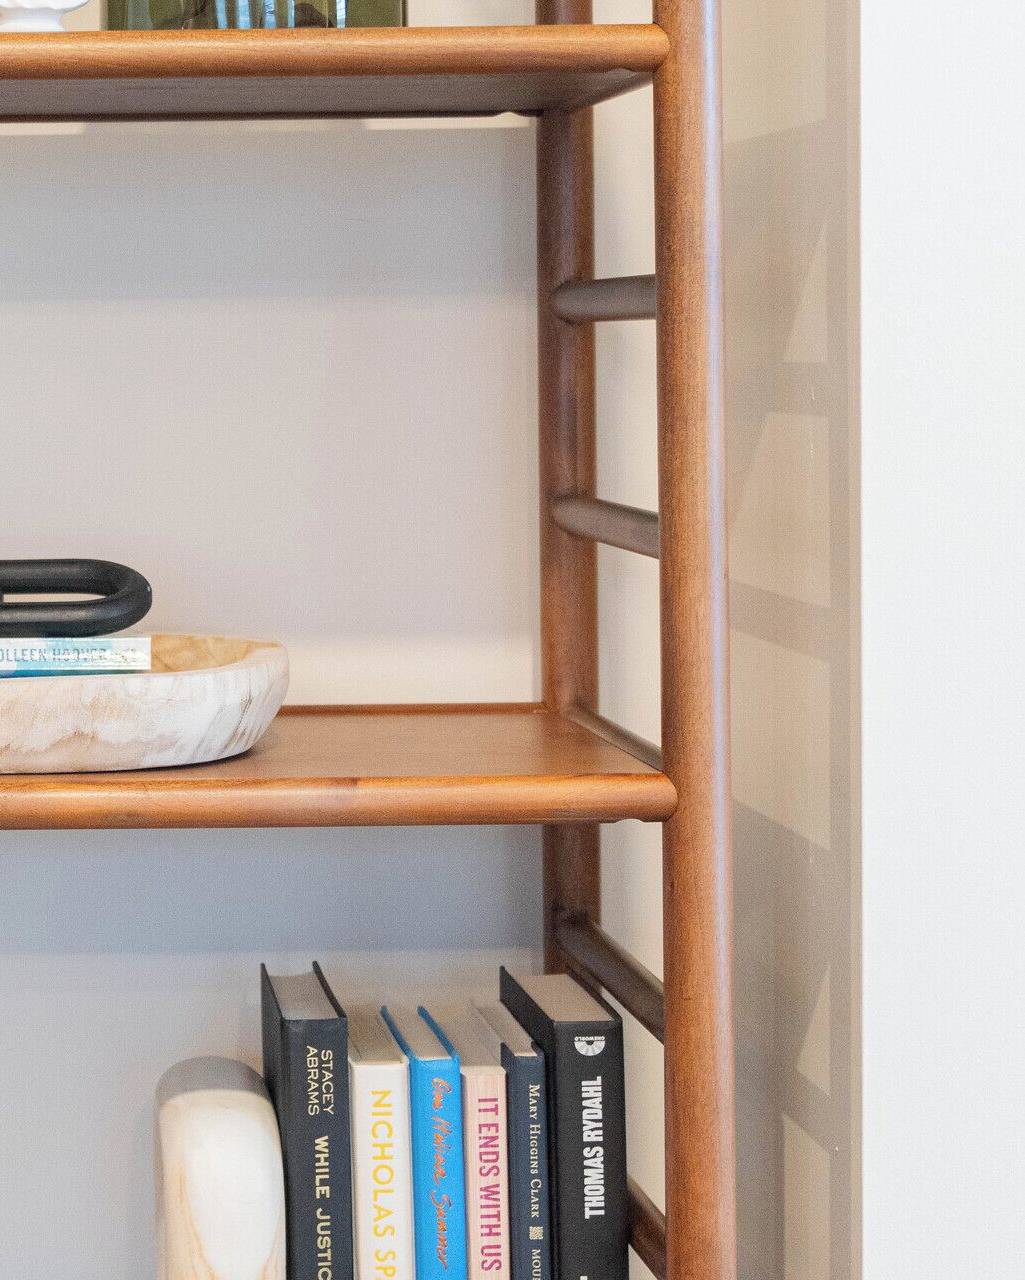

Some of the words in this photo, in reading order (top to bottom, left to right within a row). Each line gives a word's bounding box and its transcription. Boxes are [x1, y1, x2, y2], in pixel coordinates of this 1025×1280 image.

[307, 1046, 319, 1116] ABRAMS
[321, 1050, 334, 1114] STACEY
[478, 1098, 498, 1115] IT
[582, 1076, 603, 1142] RYDAHL
[315, 1136, 330, 1199] WHILE
[372, 1090, 396, 1238] NICHOLAS
[478, 1123, 500, 1177] ENDS
[480, 1184, 502, 1237] WITH
[583, 1146, 605, 1219] THOMAS
[430, 1189, 452, 1270] Summer
[481, 1244, 502, 1271] US
